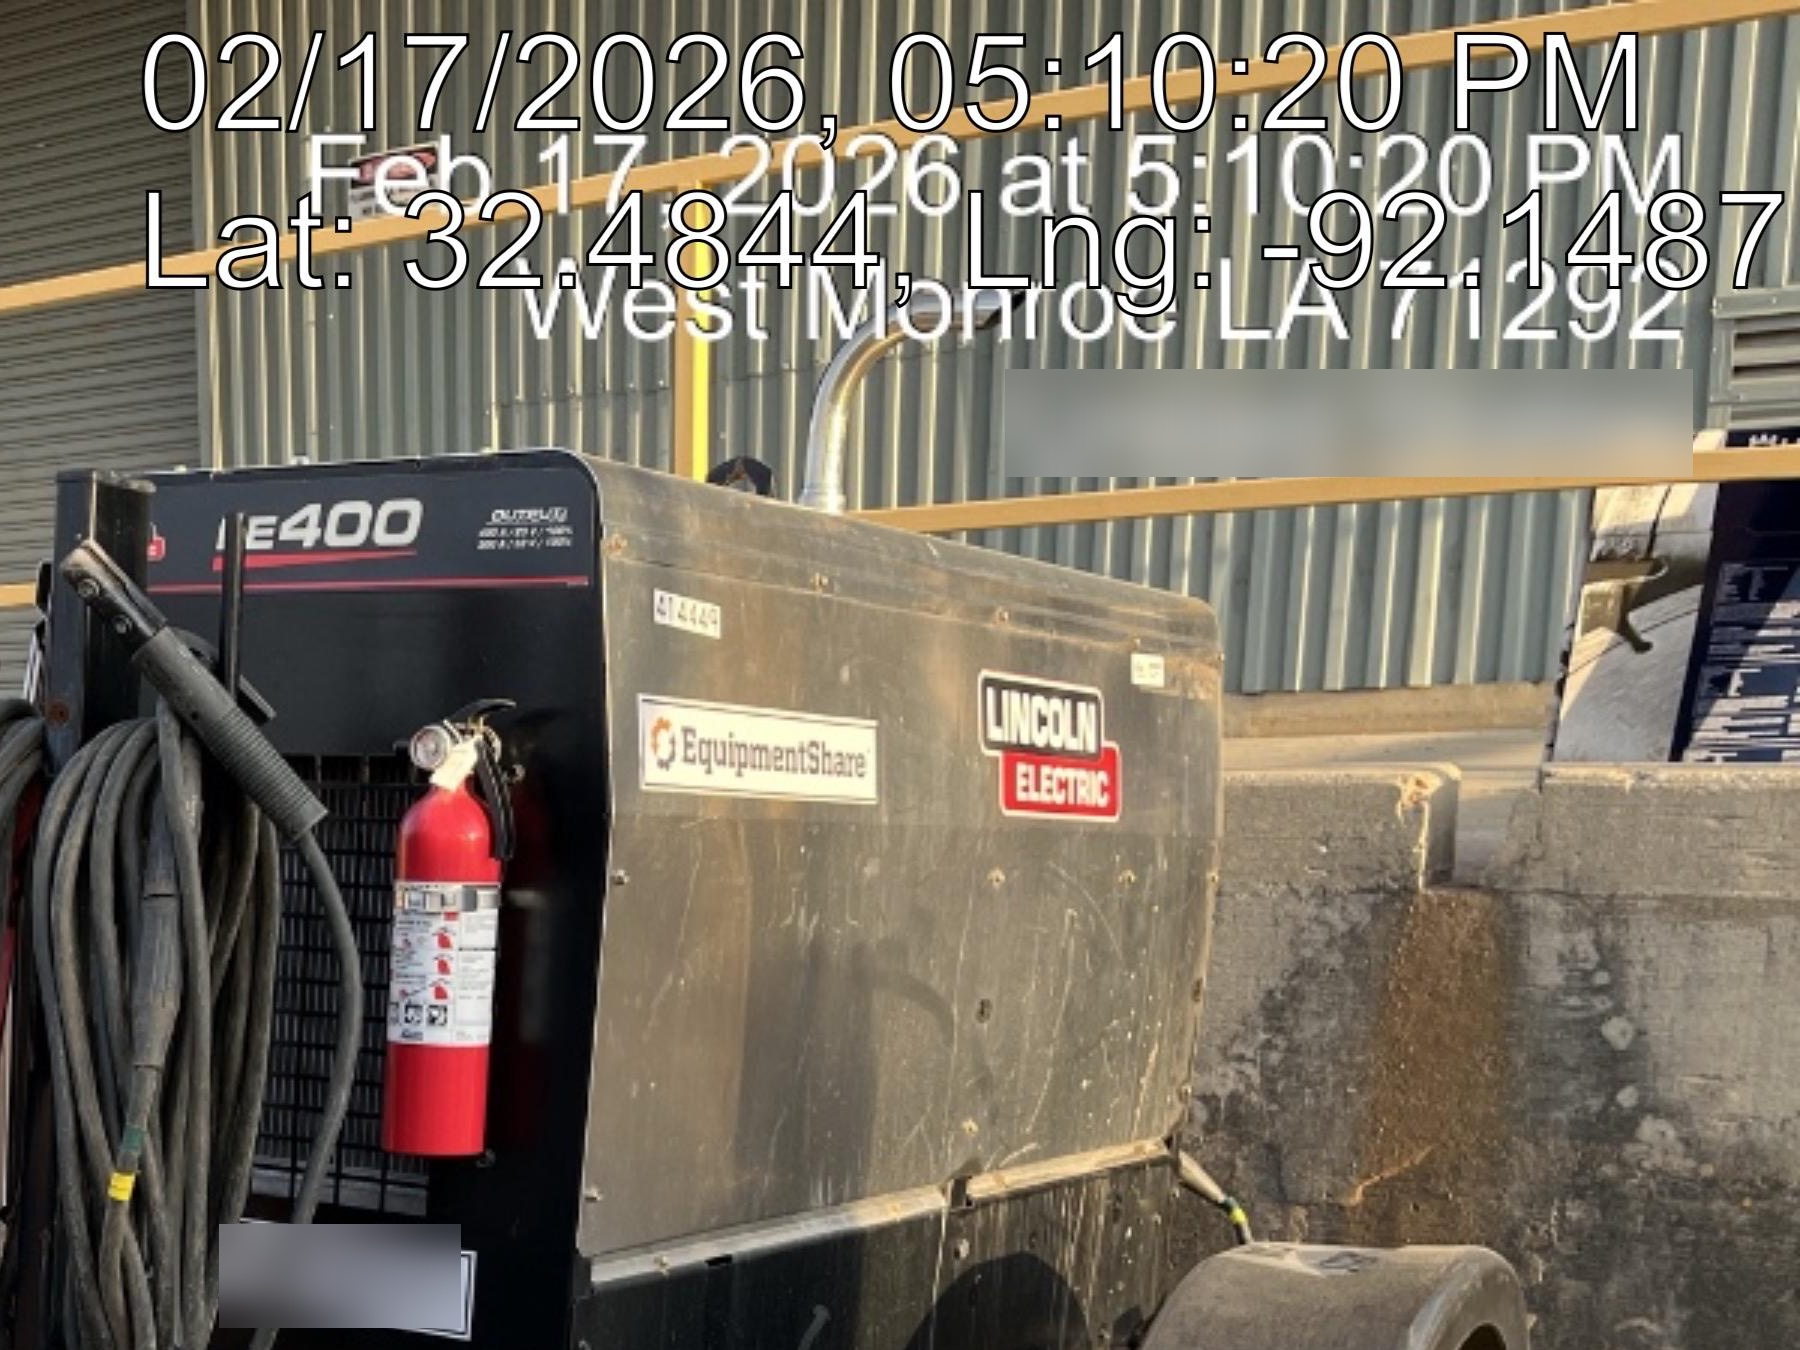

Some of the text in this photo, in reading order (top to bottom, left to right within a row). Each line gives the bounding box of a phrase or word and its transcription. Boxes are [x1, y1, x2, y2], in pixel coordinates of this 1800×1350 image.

[985, 686, 1097, 754] LINCOLN
[681, 726, 866, 778] EquipmentShare
[1015, 761, 1110, 808] ELECTRIC
